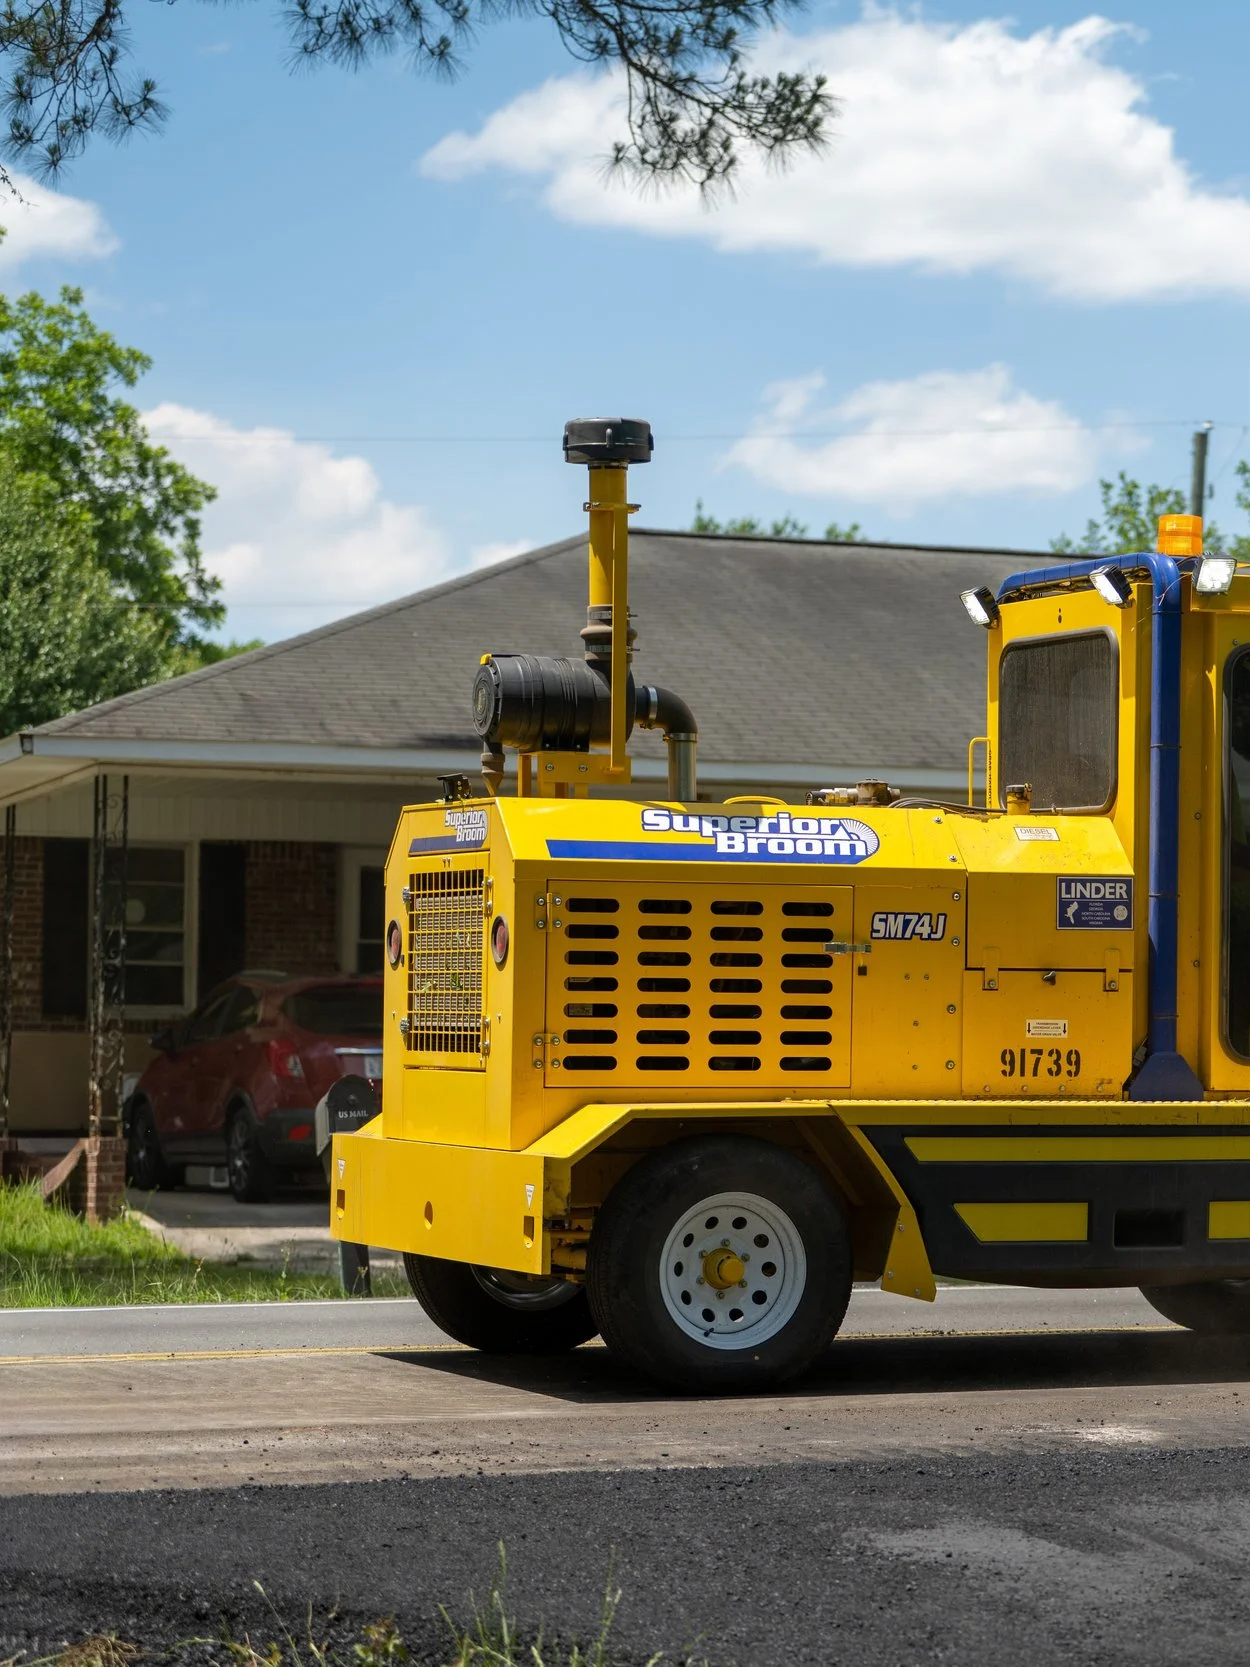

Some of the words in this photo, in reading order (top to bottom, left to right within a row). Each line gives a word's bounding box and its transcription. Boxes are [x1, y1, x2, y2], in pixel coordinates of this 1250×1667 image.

[445, 807, 485, 828] Superior
[642, 809, 843, 837] Superior
[455, 825, 485, 842] Broom
[716, 832, 868, 856] Broom
[1060, 882, 1128, 899] LINDER
[871, 913, 946, 939] SM74J
[1000, 1048, 1081, 1078] 91739
[350, 1110, 369, 1118] MAIL
